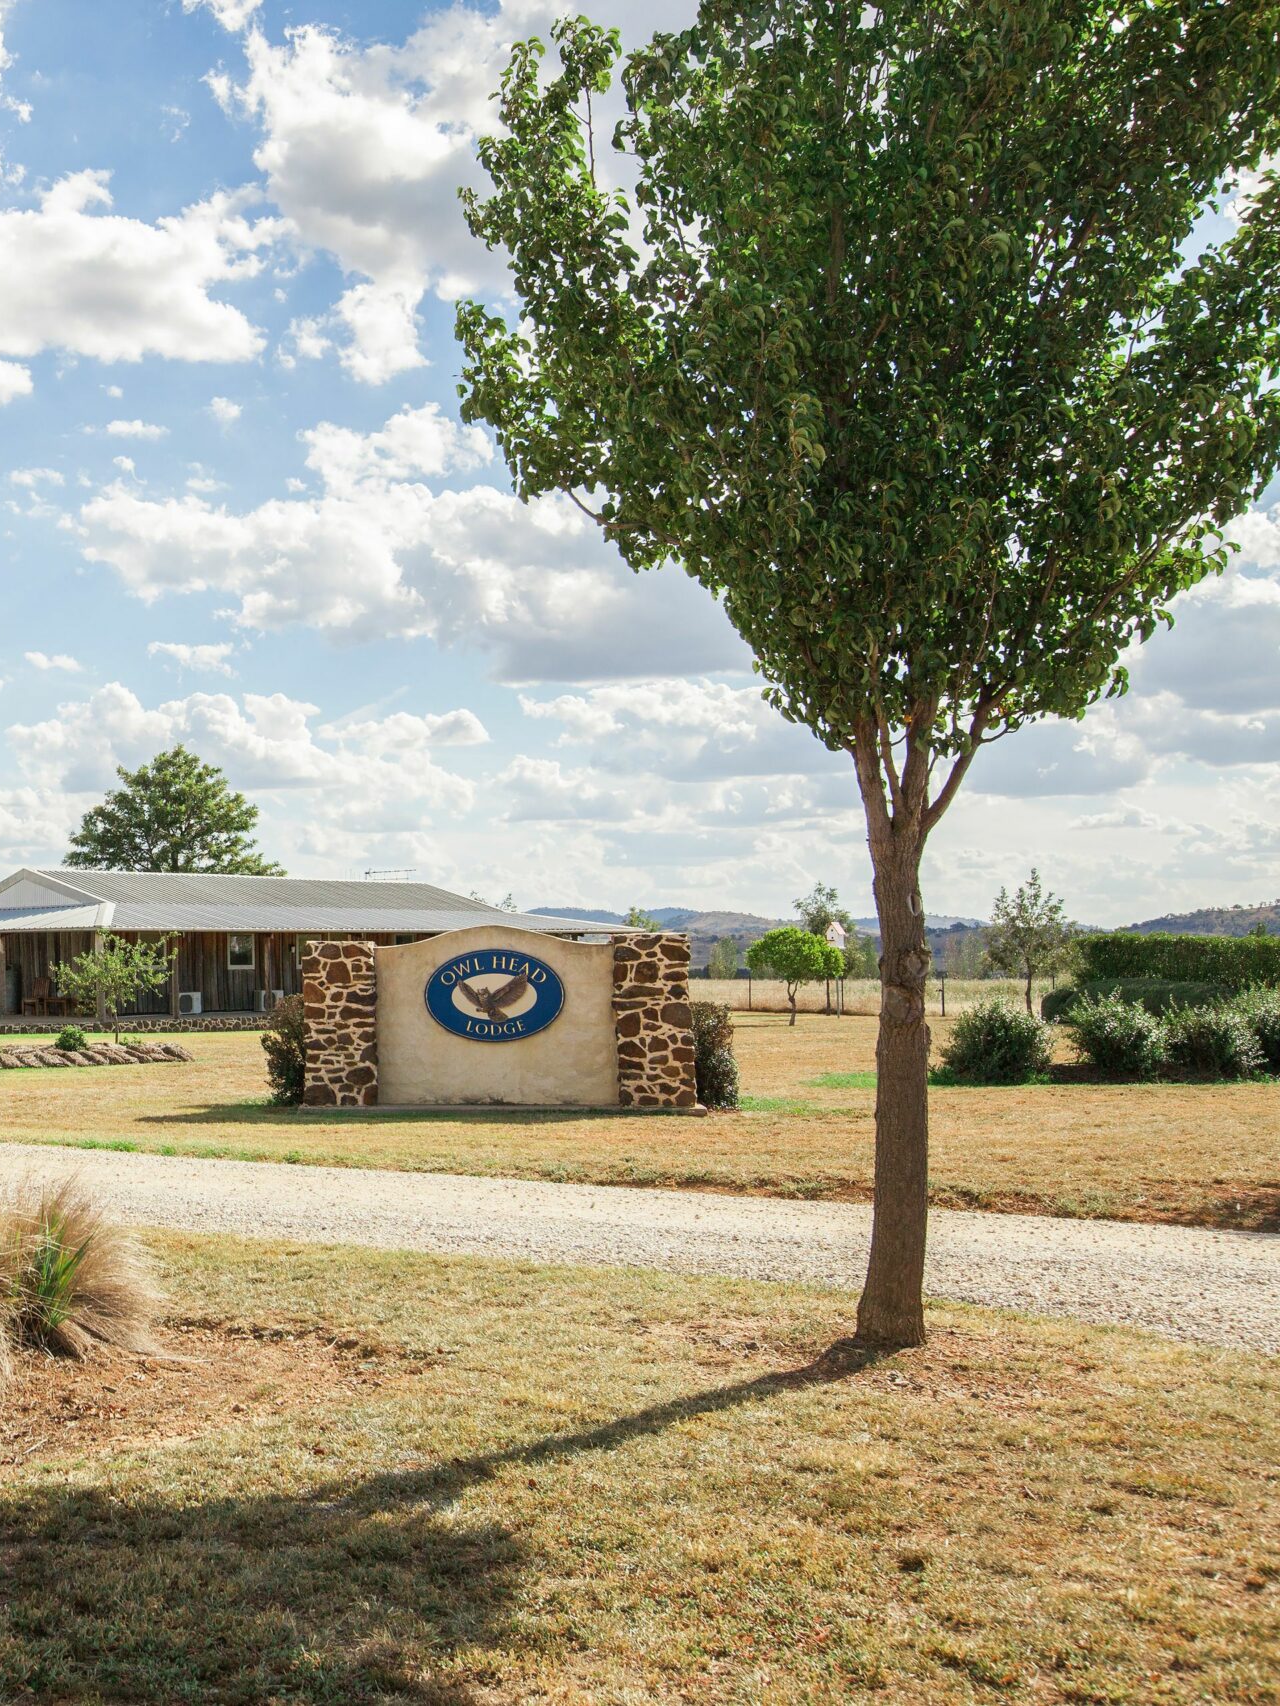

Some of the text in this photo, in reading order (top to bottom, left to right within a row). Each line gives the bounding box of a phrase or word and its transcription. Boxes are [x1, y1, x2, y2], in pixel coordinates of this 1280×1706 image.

[440, 956, 547, 985] OWL HEAD
[466, 1020, 526, 1036] LODGE
